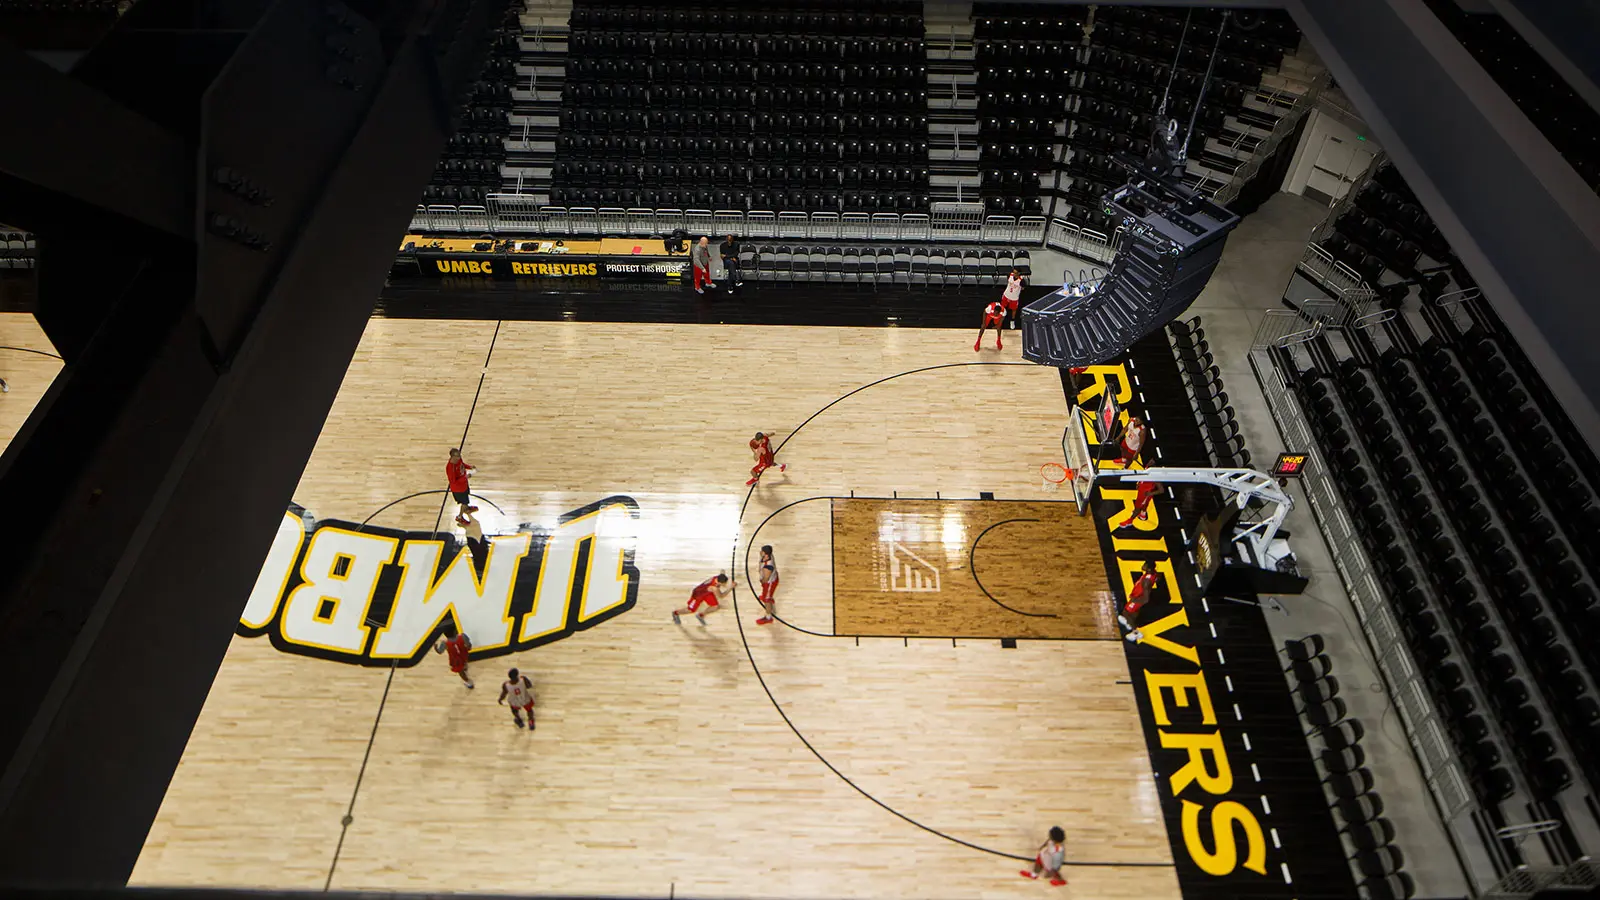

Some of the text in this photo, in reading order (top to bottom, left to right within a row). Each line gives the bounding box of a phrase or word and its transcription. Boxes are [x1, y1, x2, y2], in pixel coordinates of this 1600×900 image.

[436, 260, 493, 274] UMBC
[511, 262, 597, 276] RETRIEVERS
[606, 264, 640, 273] PROTECT
[641, 264, 655, 273] THIS
